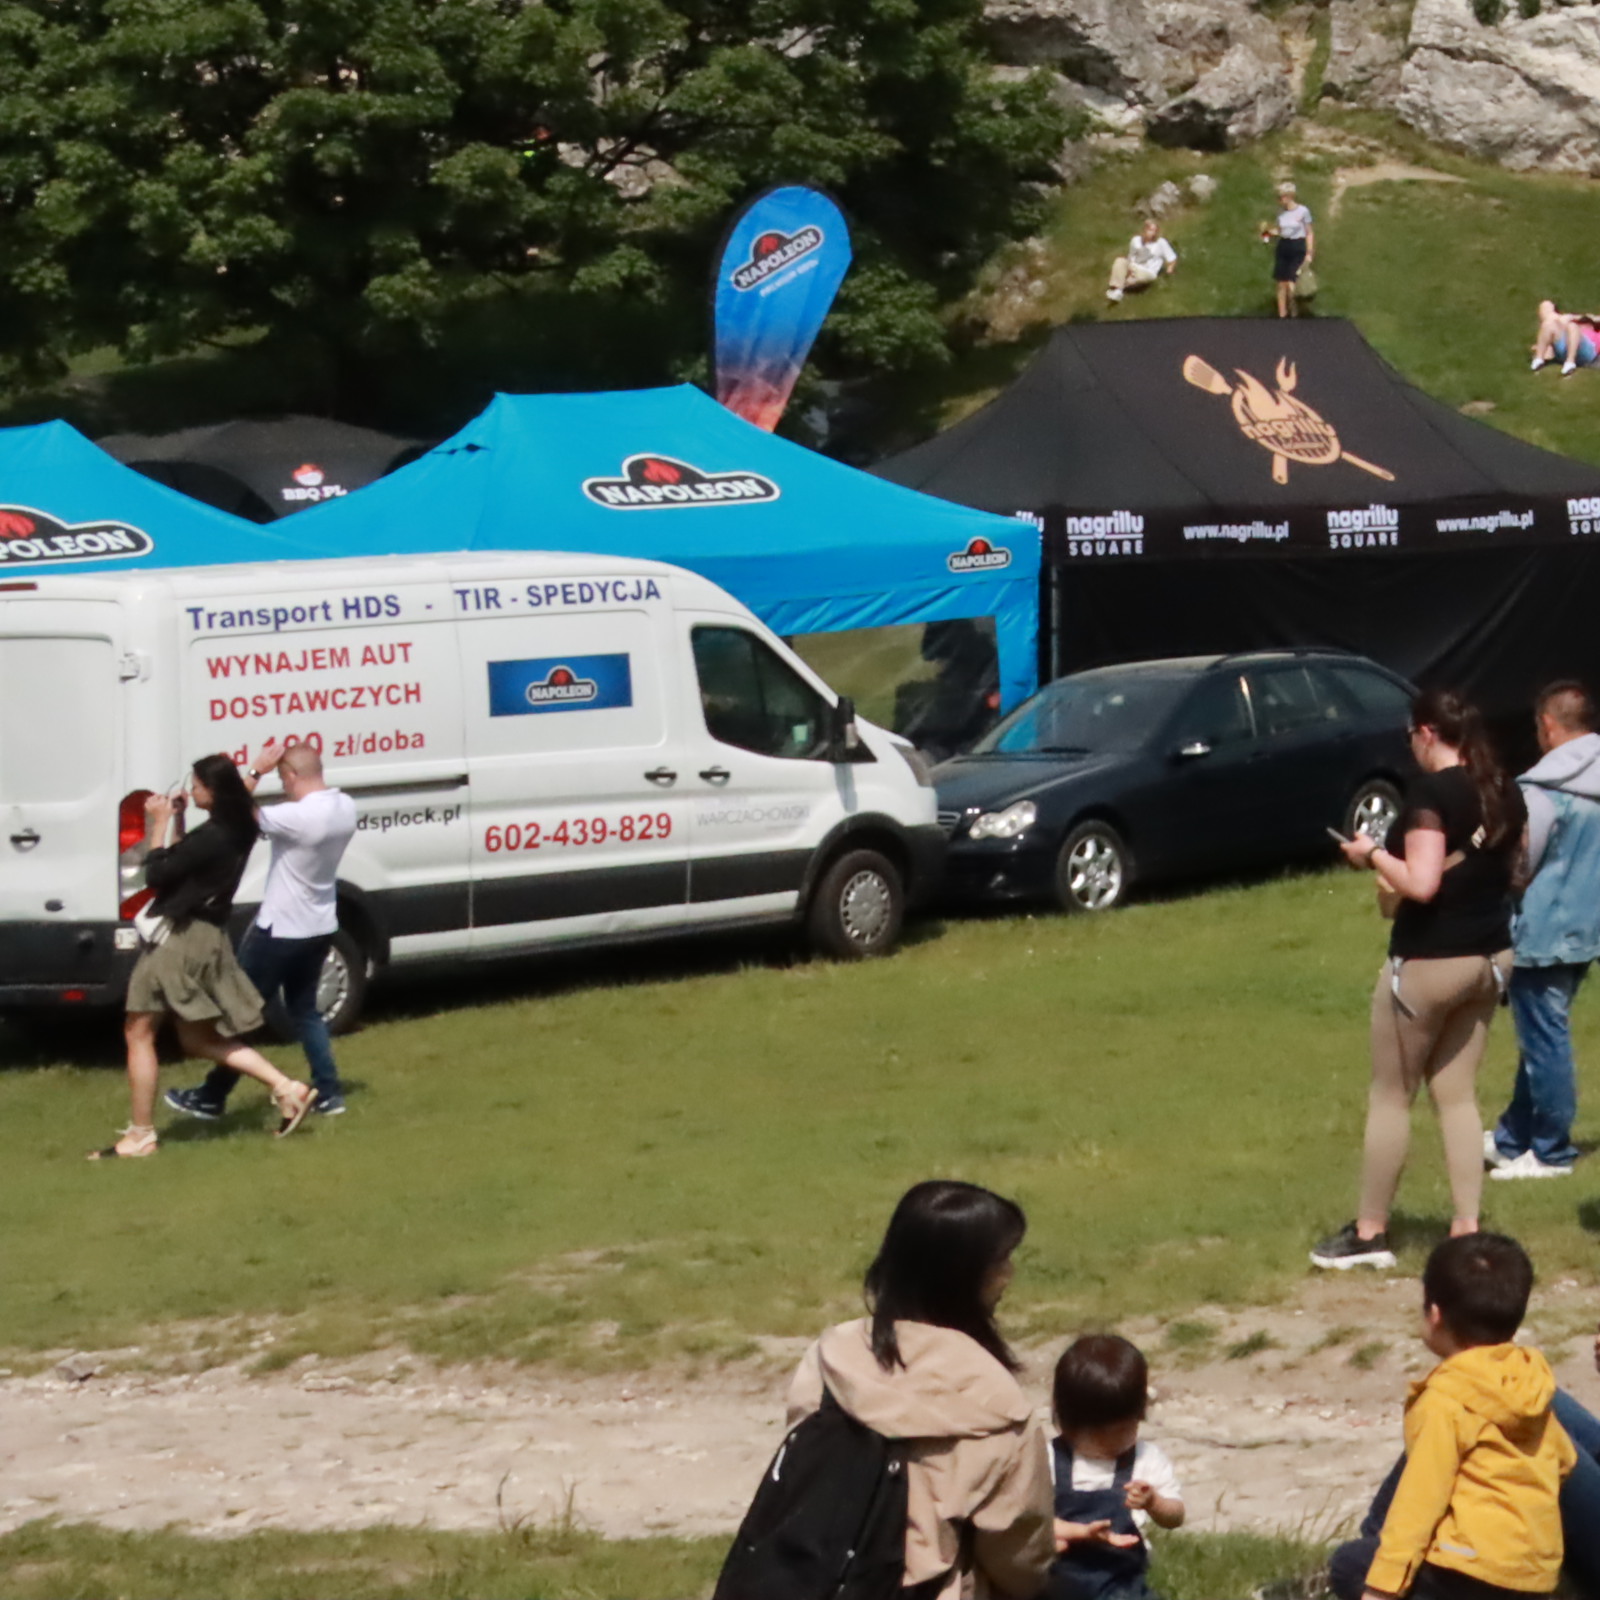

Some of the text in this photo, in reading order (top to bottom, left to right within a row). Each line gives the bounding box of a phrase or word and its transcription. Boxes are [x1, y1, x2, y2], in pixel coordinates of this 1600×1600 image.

[737, 230, 818, 287] NAPOLEON
[596, 478, 765, 504] NAPOLEON
[1067, 510, 1144, 538] nagrillu
[1183, 520, 1289, 543] www.nagrillu.pl
[1327, 504, 1398, 531] nagrillu
[1436, 510, 1534, 533] www.nagrillu.pl
[0, 529, 136, 560] OLEON
[1068, 540, 1143, 557] SQUARE
[1329, 532, 1398, 549] SQUARE
[951, 553, 1007, 569] NAPOLEON
[186, 600, 333, 631] Transport
[342, 594, 401, 620] HDS
[454, 587, 503, 611] TIR
[526, 579, 662, 608] SPEDYCJA
[207, 642, 413, 679] WYNAJEM AUT
[210, 682, 422, 721] DOSTAWCZYCH
[532, 683, 592, 700] NAPOLEON
[333, 729, 425, 758] zł/doba
[357, 803, 461, 833] dsplock.pl
[485, 812, 672, 853] 602-439-829
